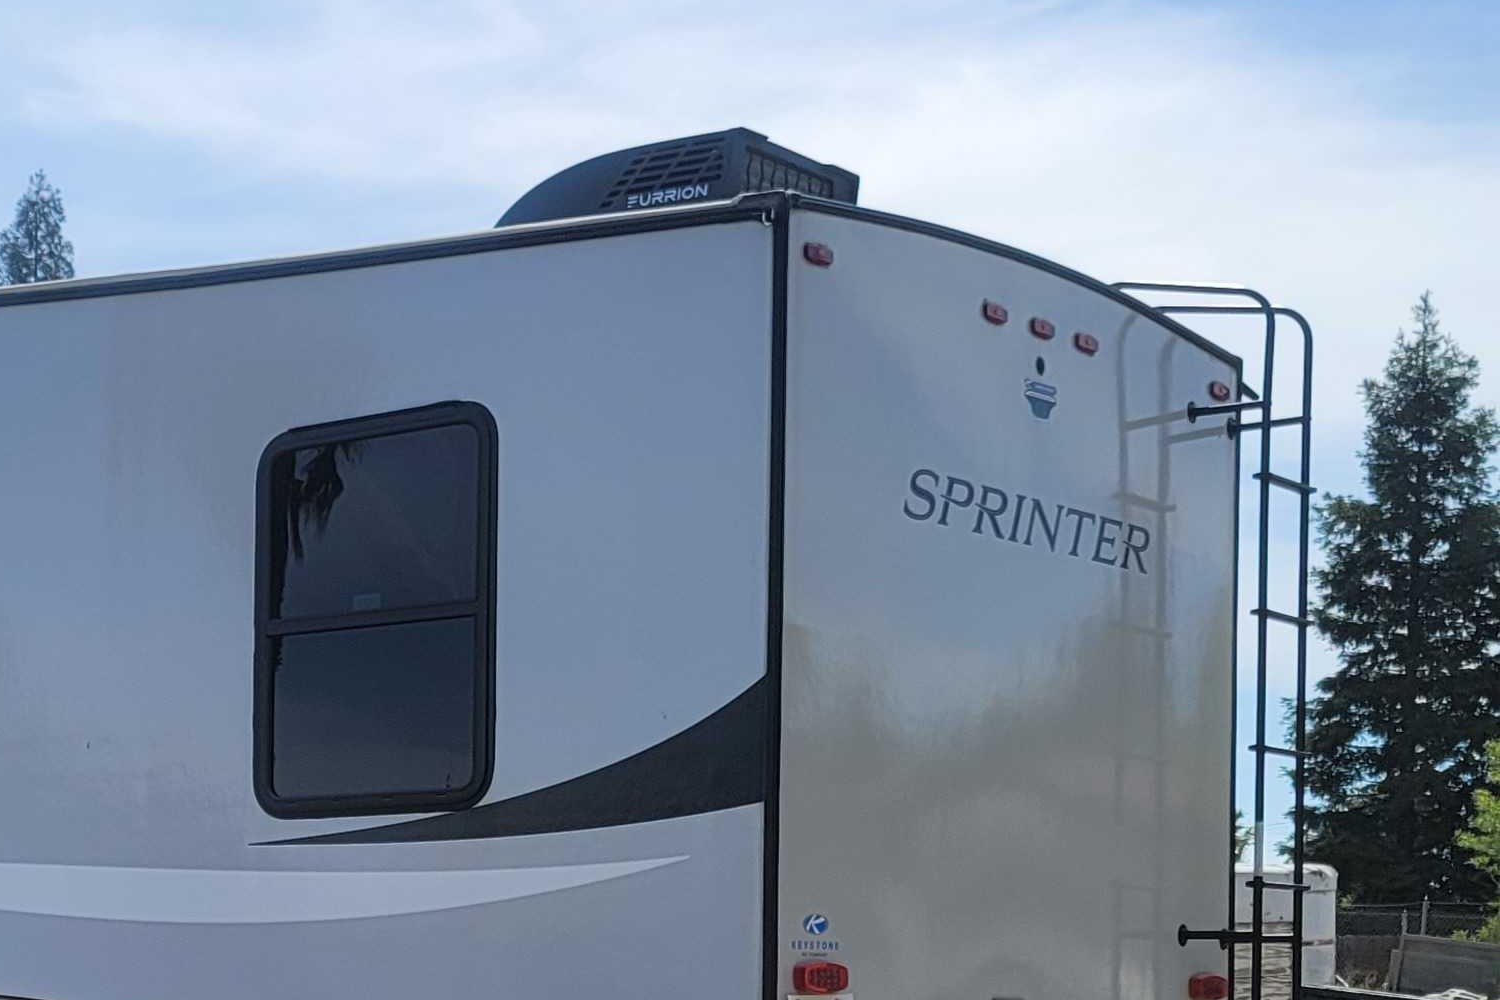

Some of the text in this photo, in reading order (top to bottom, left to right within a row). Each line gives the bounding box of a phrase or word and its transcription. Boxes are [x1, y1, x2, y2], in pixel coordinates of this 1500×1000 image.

[627, 183, 708, 208] FURRION
[903, 468, 1150, 574] SPRINTER
[791, 940, 839, 951] KEYSTONE
